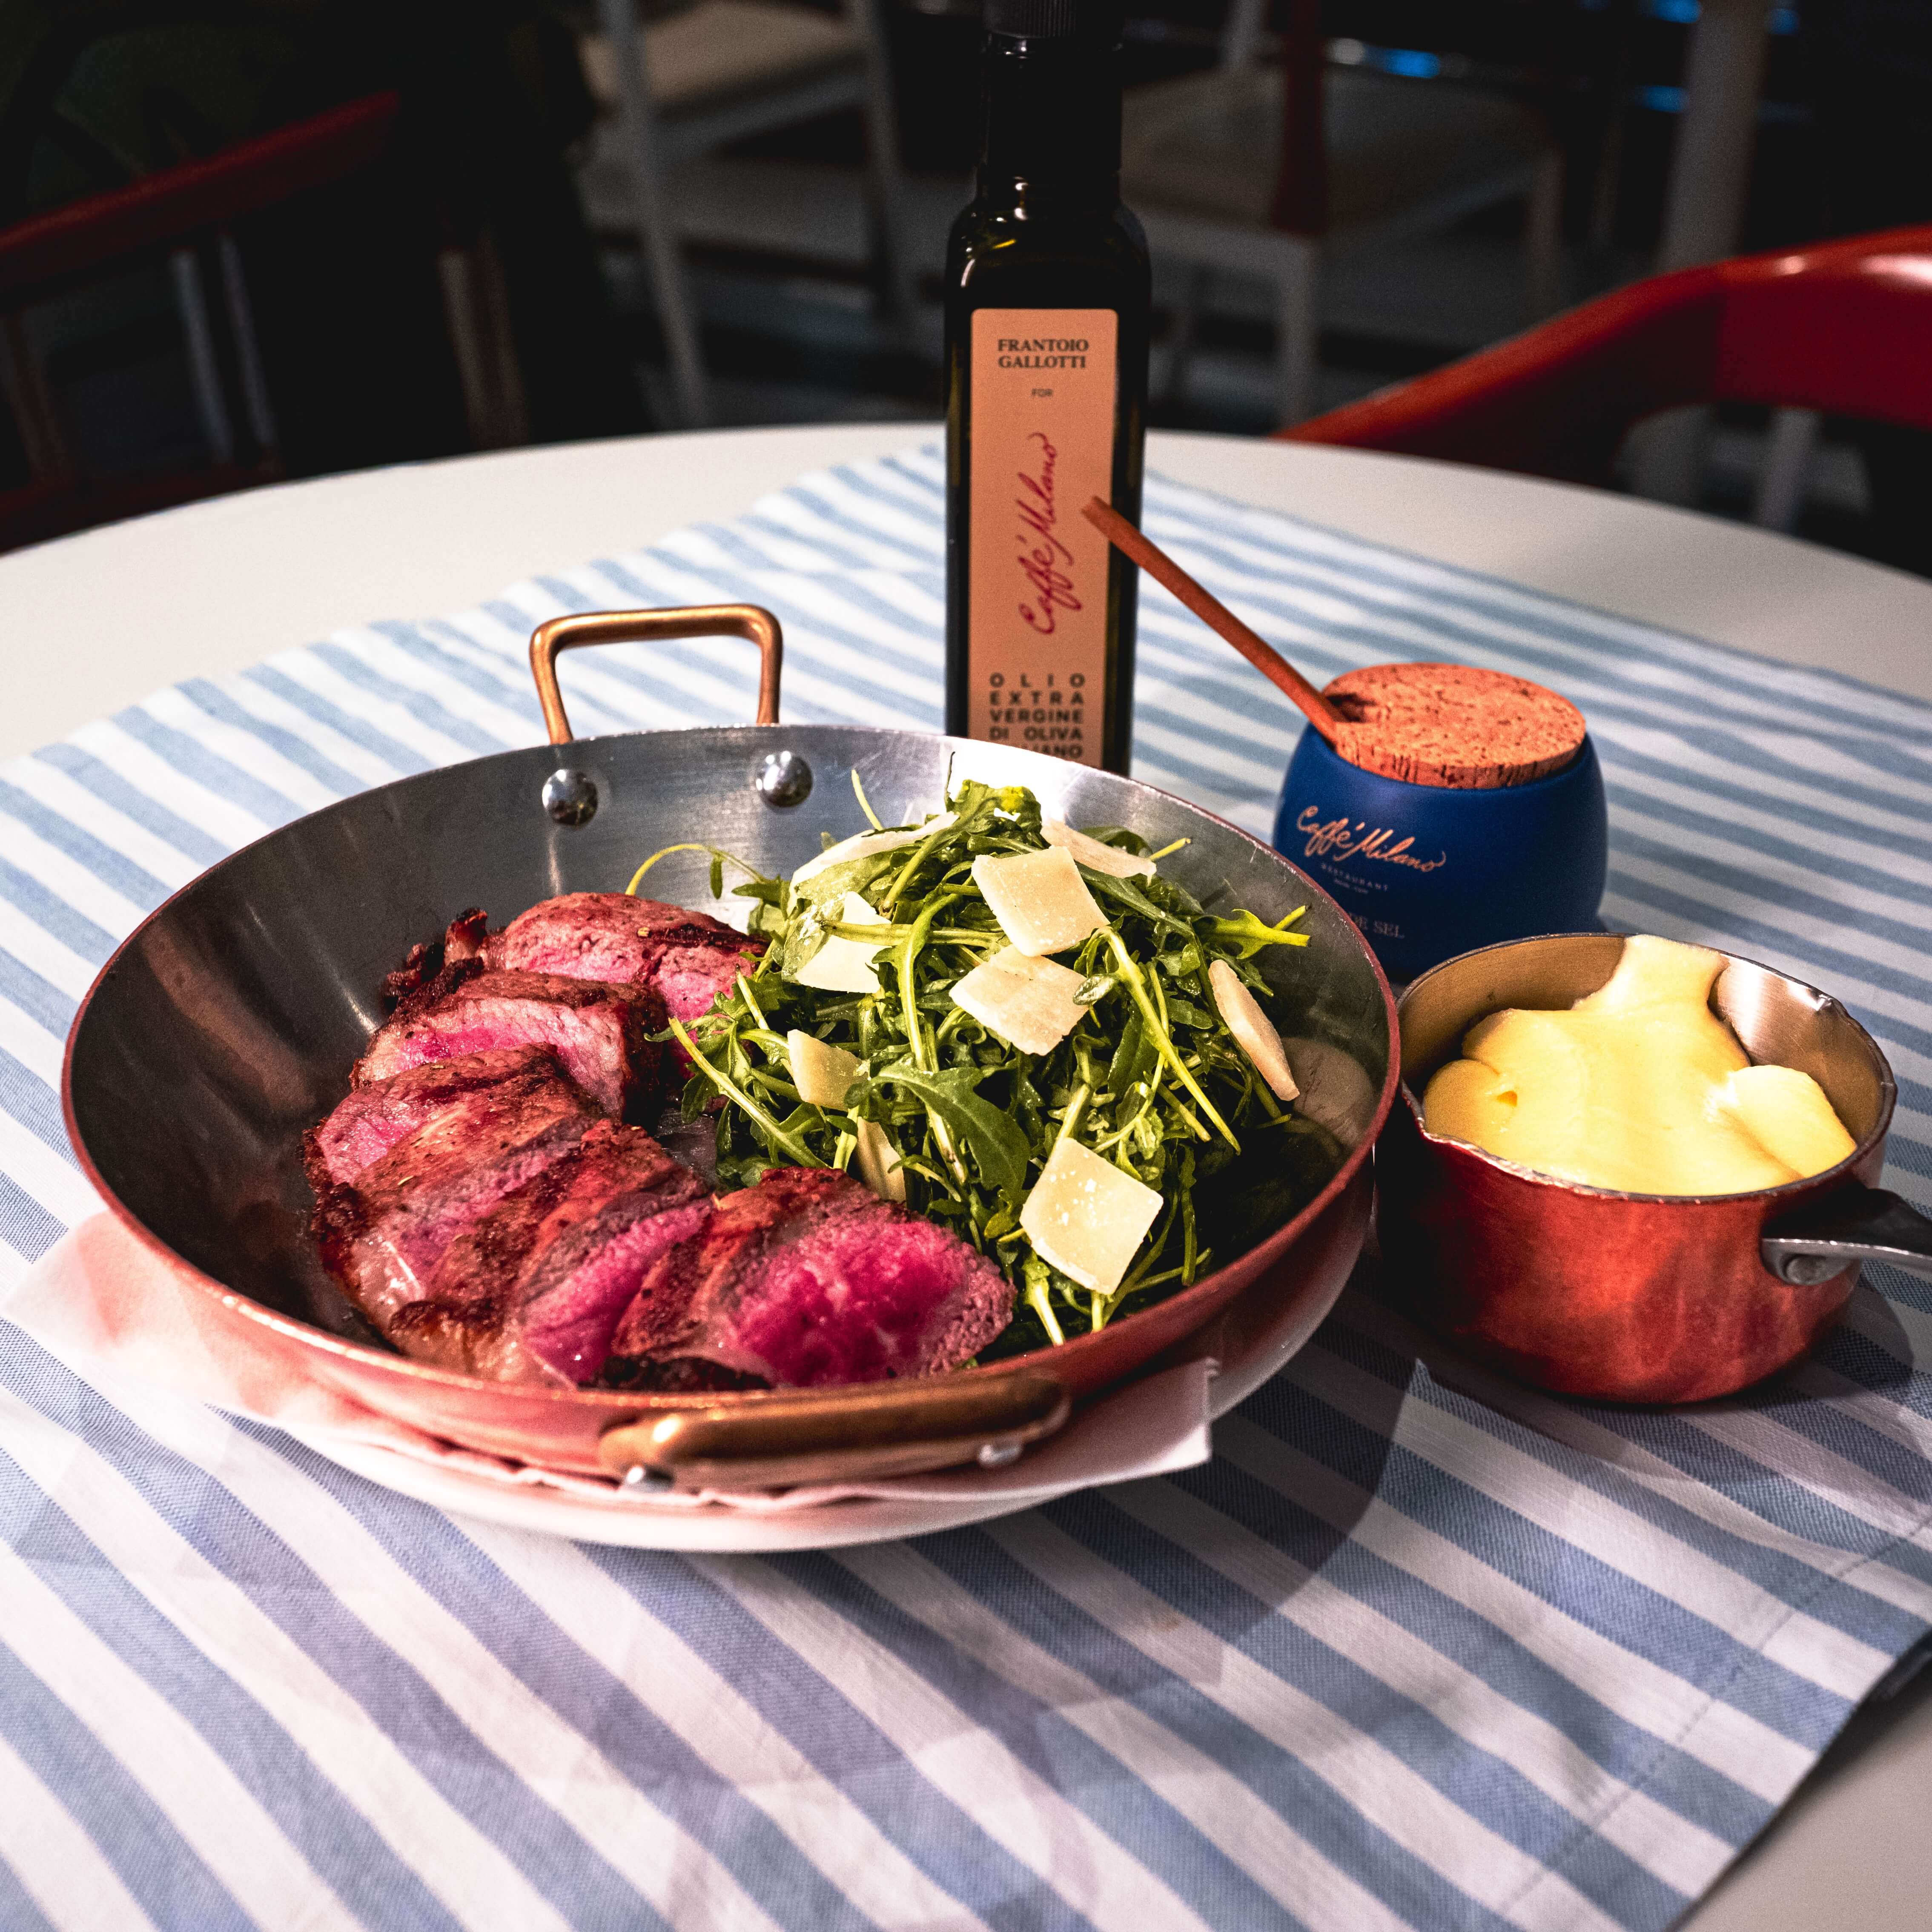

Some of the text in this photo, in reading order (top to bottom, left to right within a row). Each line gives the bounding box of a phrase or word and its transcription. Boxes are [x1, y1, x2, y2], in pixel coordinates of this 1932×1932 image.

[998, 339, 1089, 351] FRANTOIO
[998, 355, 1086, 368] GALLOTTI
[1032, 388, 1052, 397] FOR
[1016, 432, 1074, 566] Milano
[990, 691, 1084, 705] EXTRA
[989, 709, 1084, 723] VERGINE
[989, 727, 1083, 740] DI OLIVA
[1333, 828, 1446, 872] Milano
